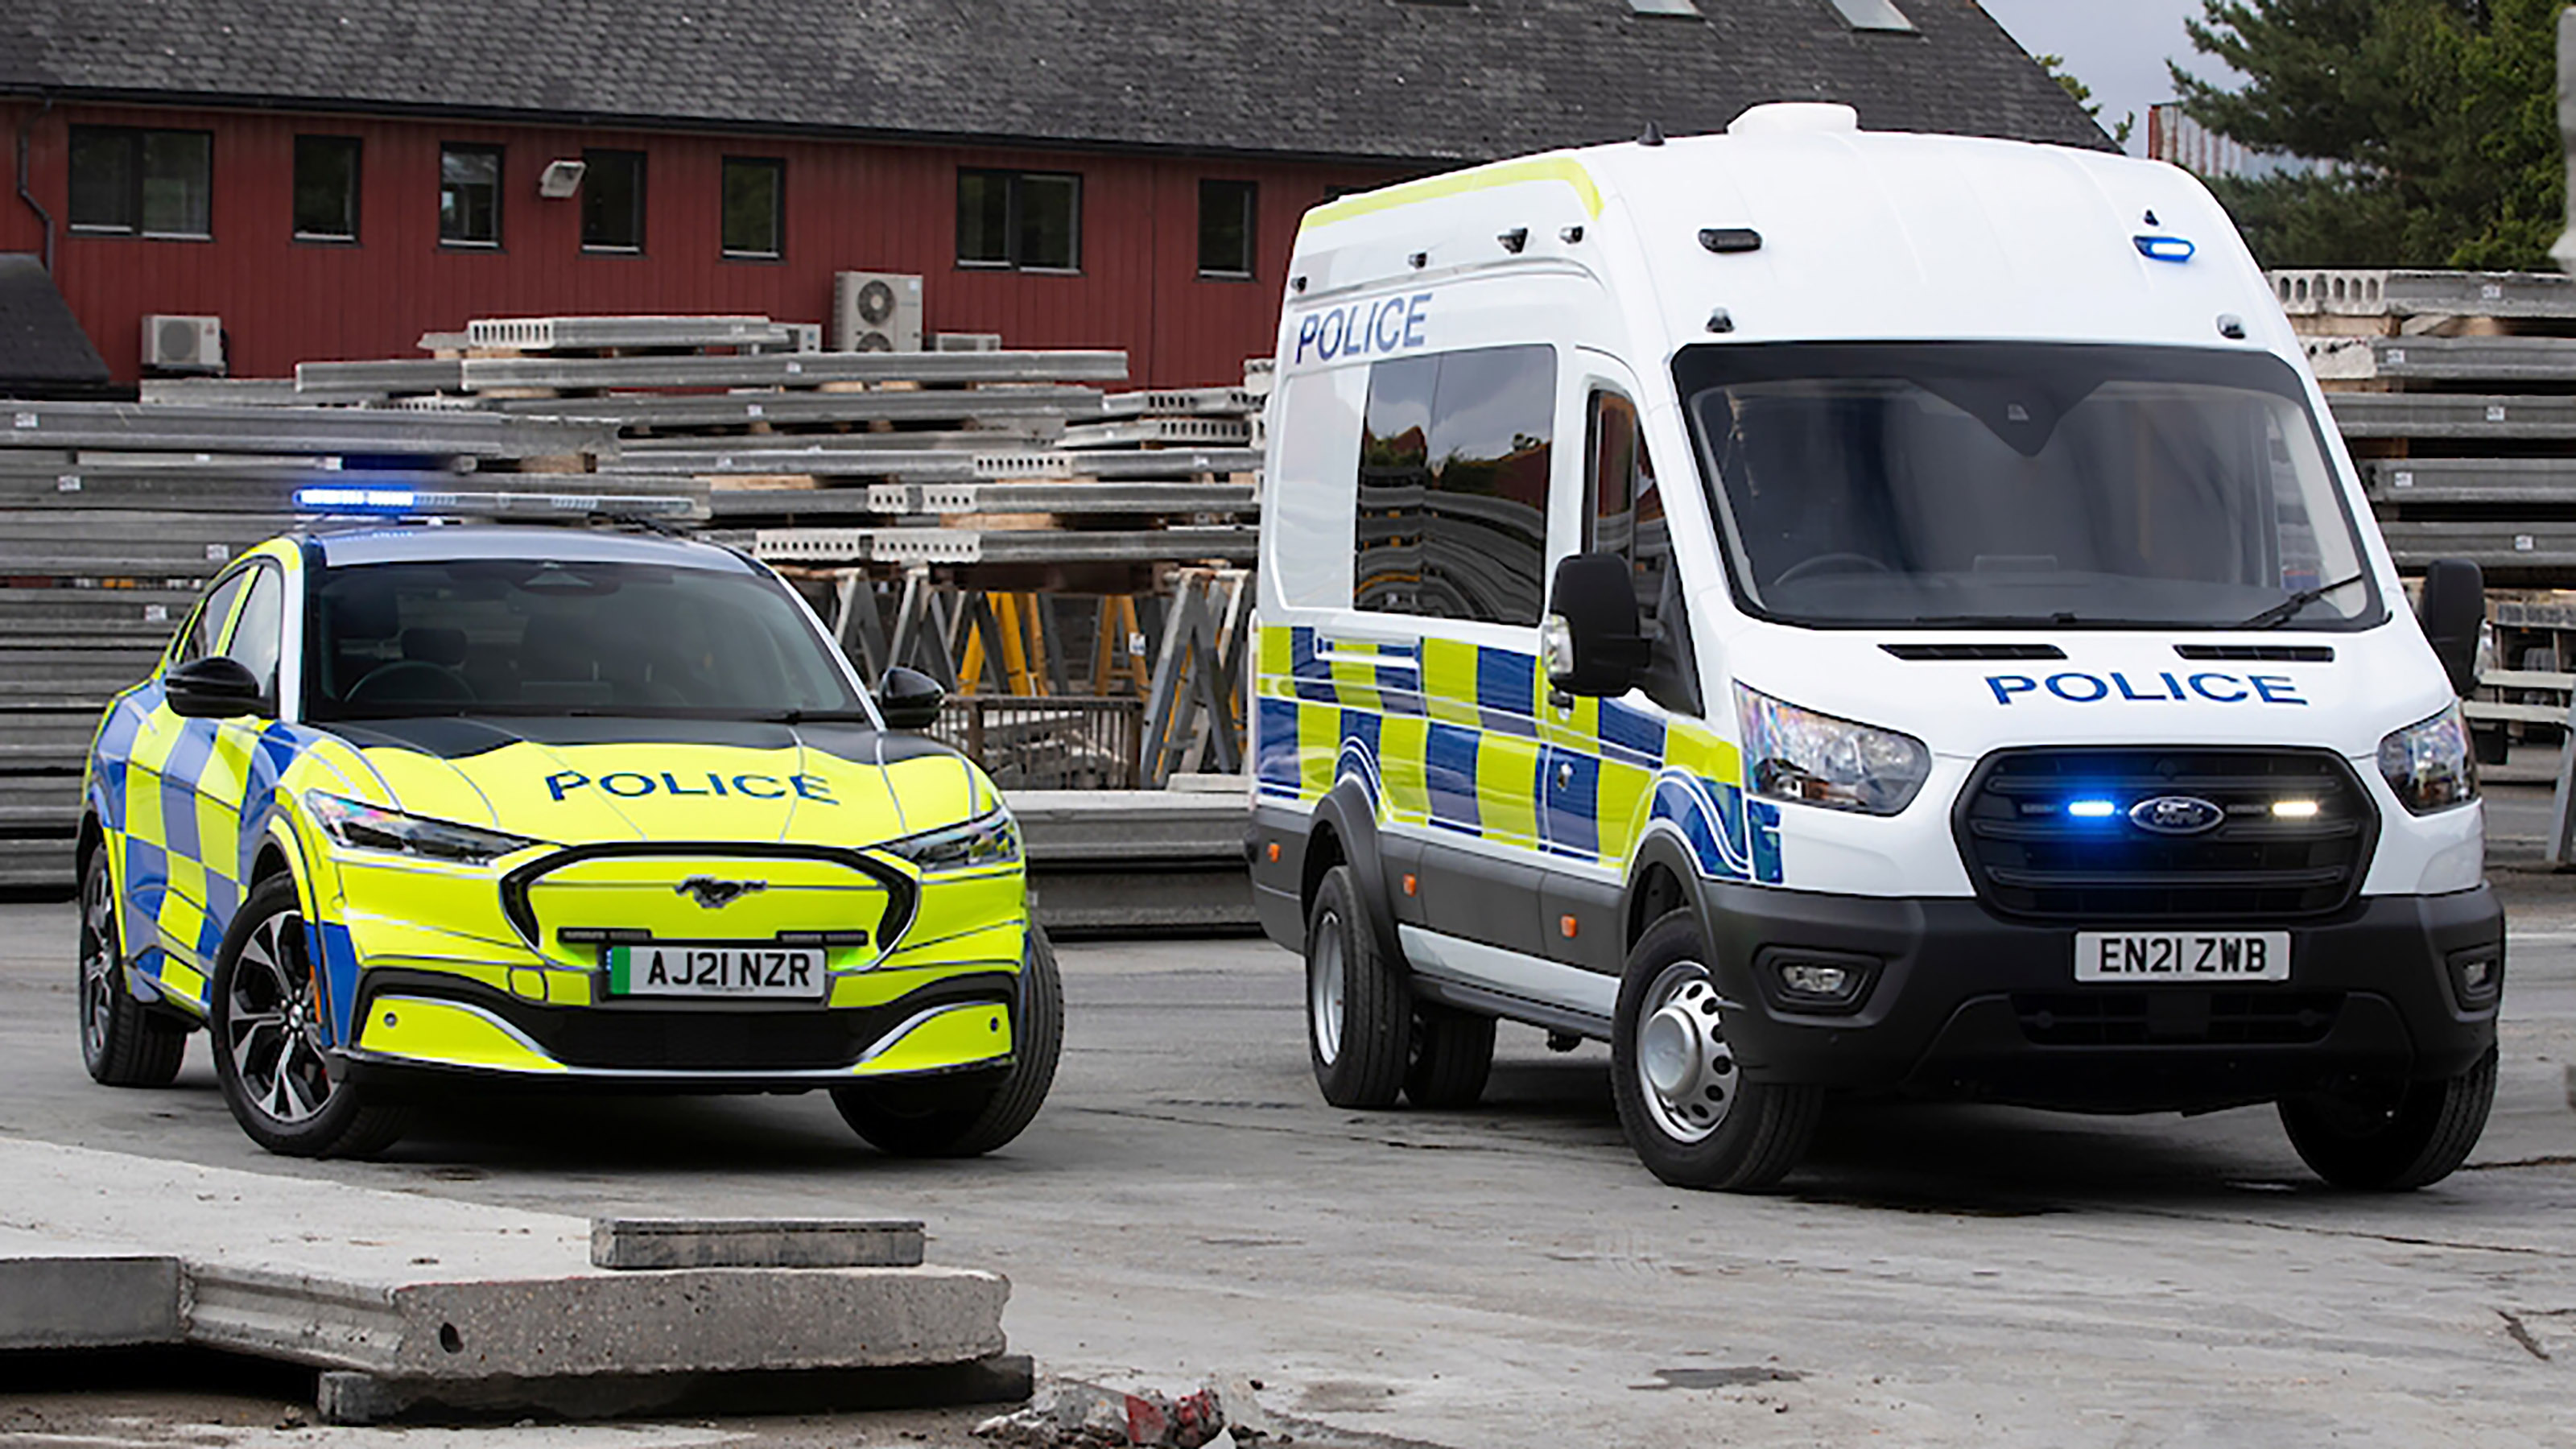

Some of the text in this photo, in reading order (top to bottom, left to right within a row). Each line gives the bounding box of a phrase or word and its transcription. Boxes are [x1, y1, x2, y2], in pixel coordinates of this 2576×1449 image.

[1294, 291, 1433, 364] POLICE
[1984, 671, 2309, 705] POLICE
[544, 770, 840, 806] POLICE
[647, 950, 810, 987] AJ21 NZR
[2099, 937, 2267, 973] EN21 ZWB
